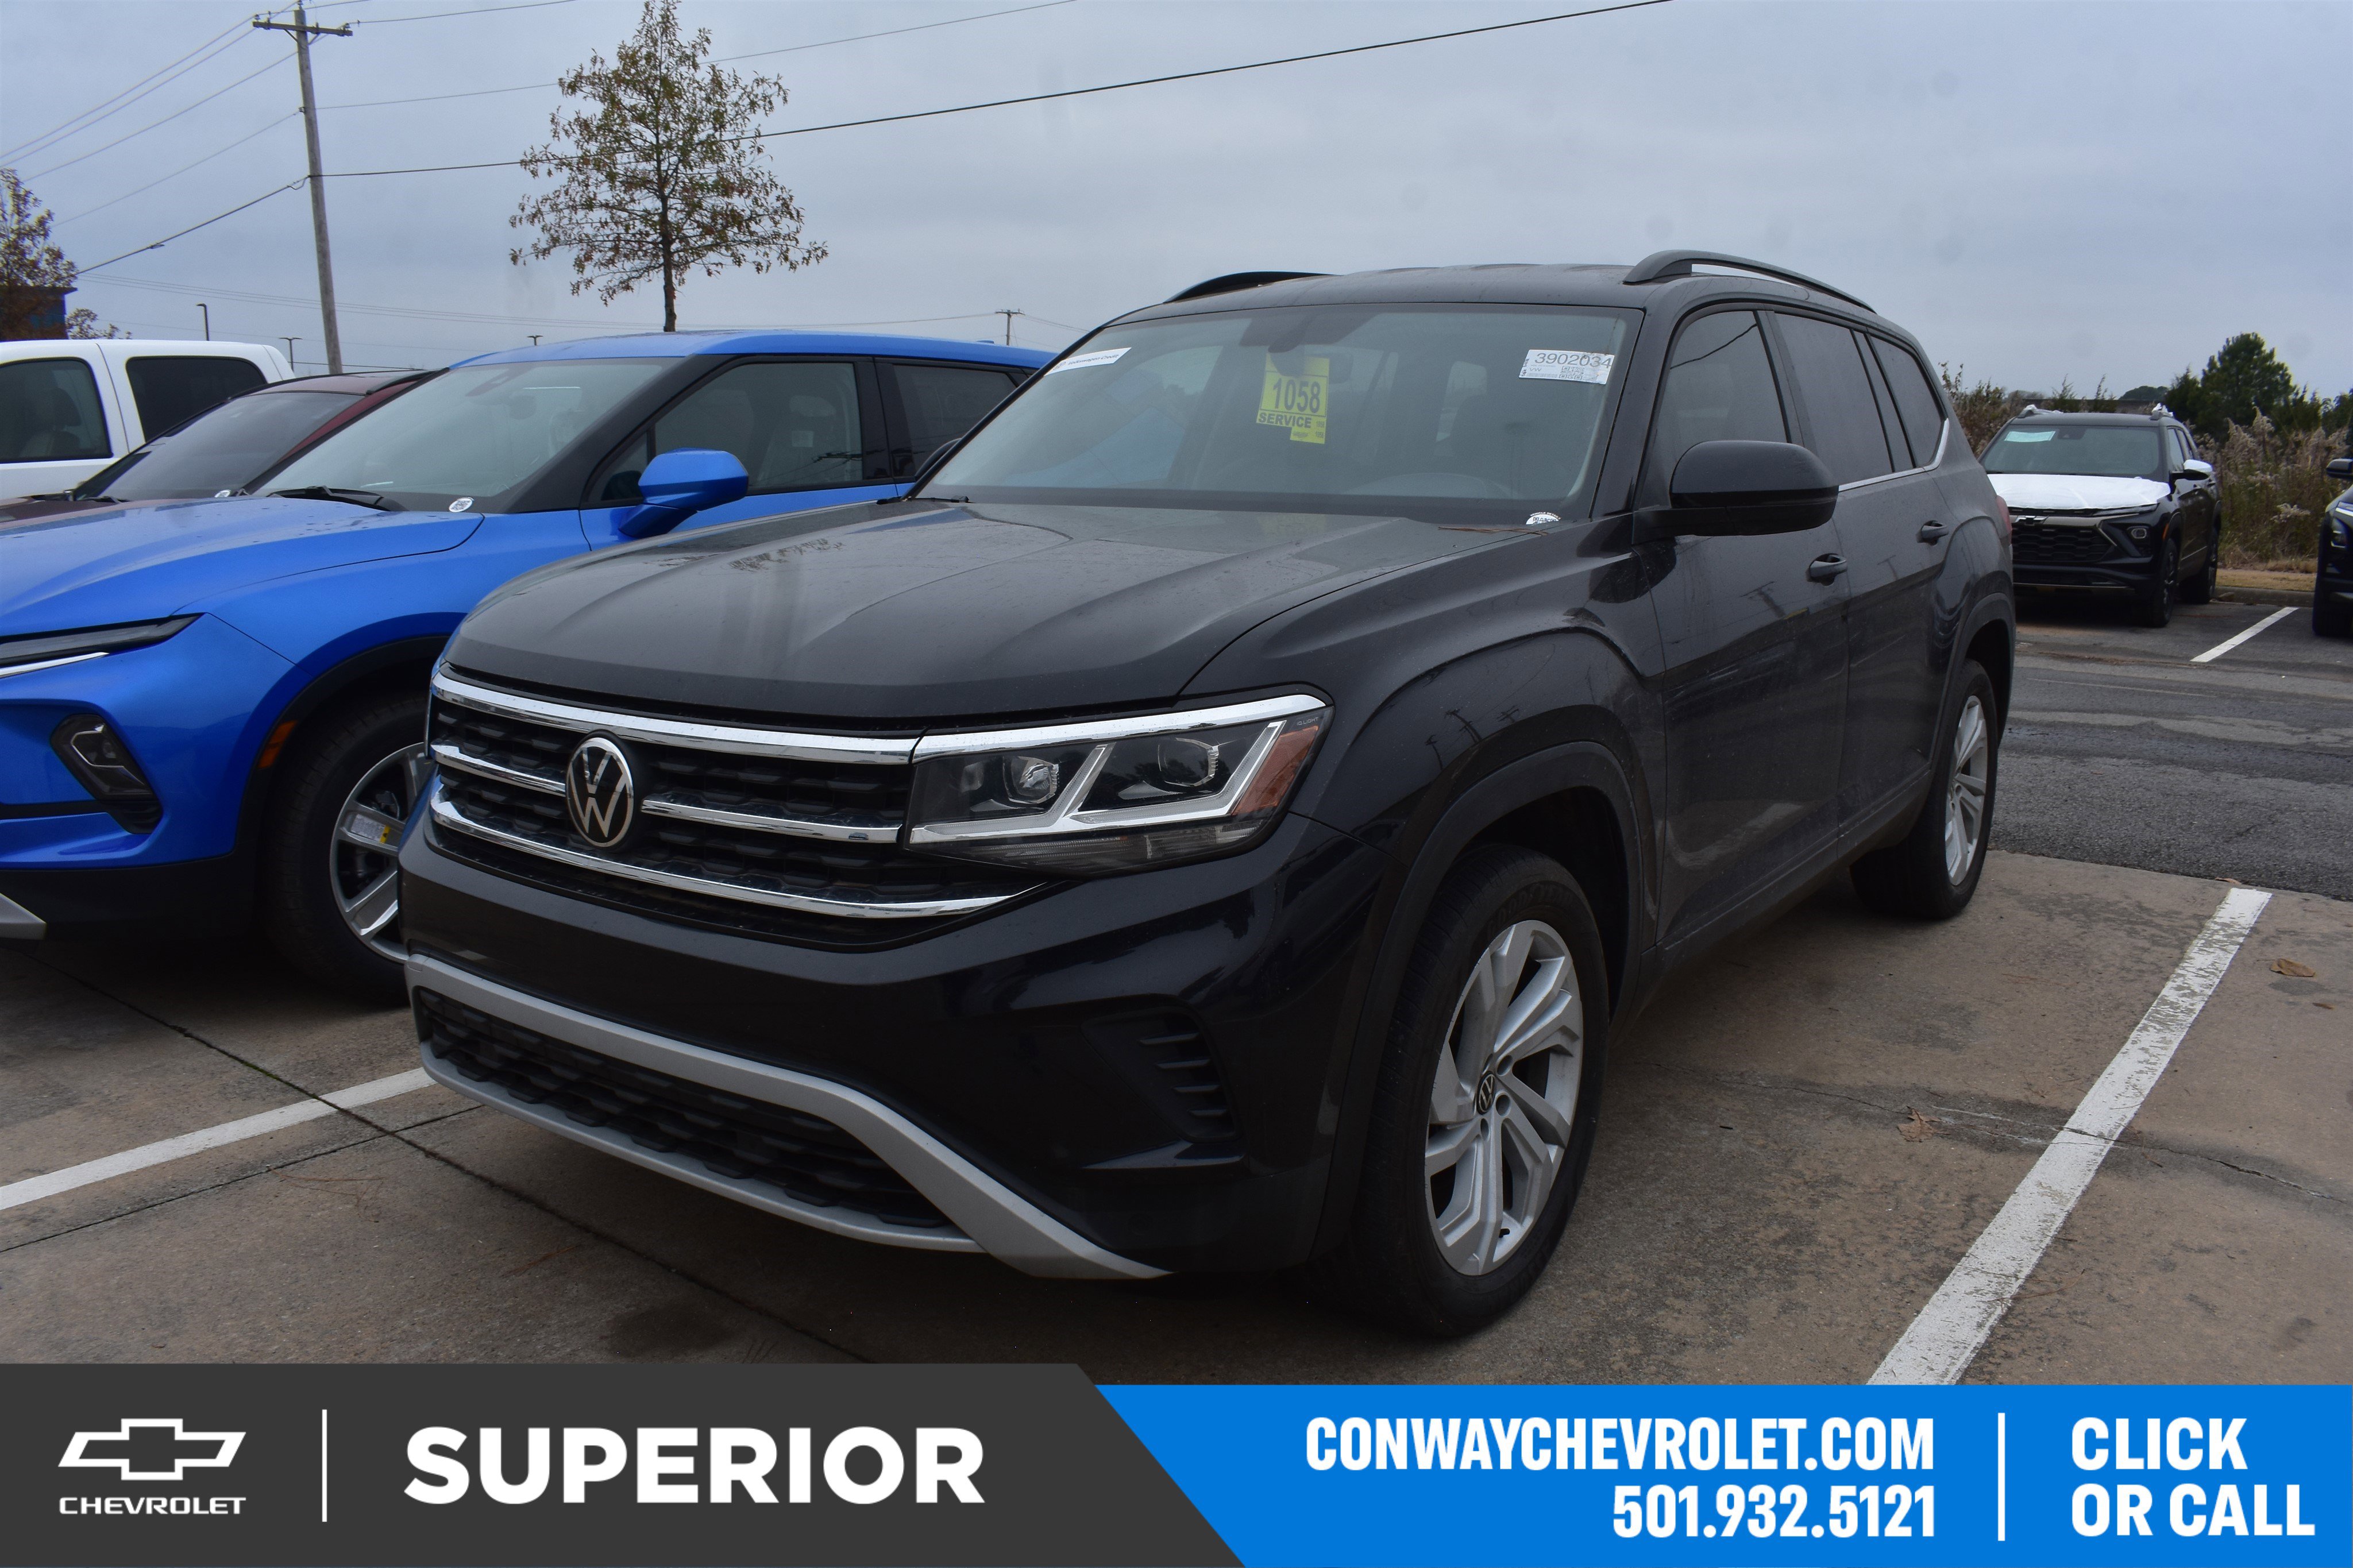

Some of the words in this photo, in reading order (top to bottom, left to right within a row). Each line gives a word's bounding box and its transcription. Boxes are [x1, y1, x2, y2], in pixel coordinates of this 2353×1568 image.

[1534, 353, 1612, 369] 3902034
[1273, 377, 1321, 414] 1058
[1259, 412, 1312, 428] SERVICE
[568, 742, 631, 842] VW
